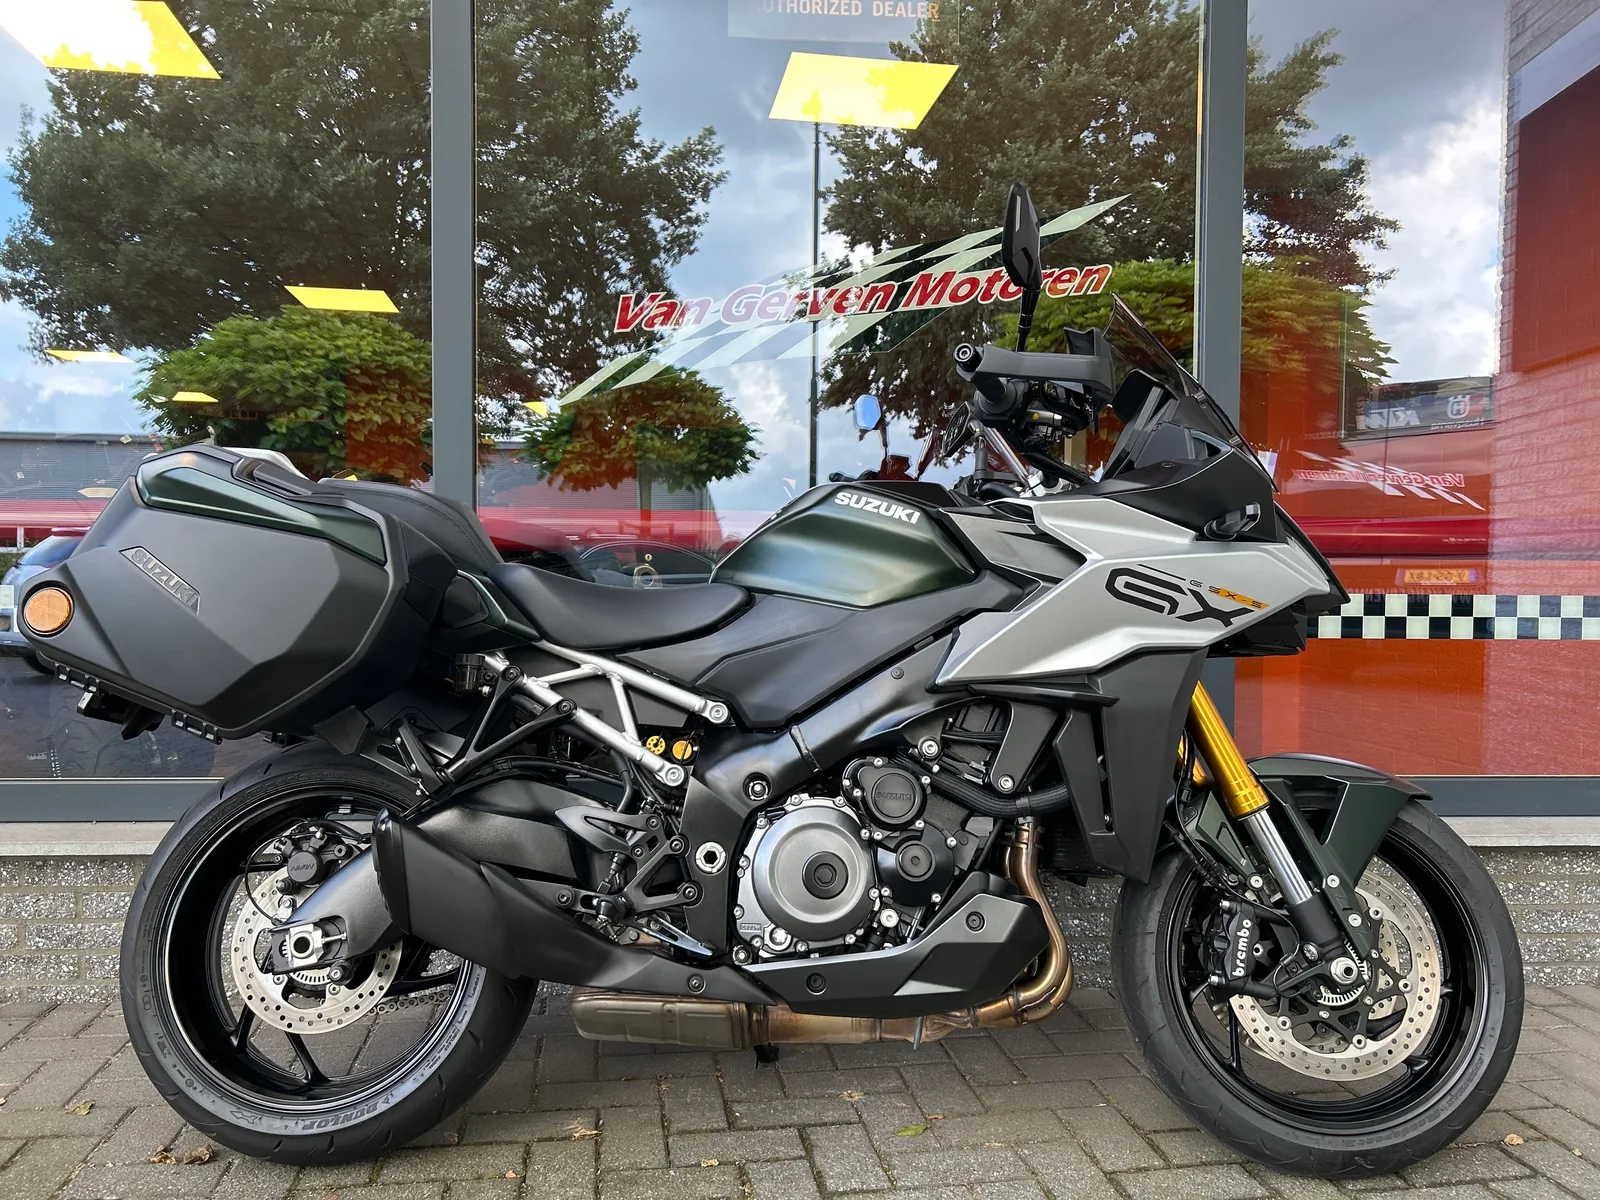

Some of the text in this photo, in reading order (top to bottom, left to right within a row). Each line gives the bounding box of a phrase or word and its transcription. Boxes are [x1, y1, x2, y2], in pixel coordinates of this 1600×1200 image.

[755, 0, 940, 19] UTHORIZED DEALER
[613, 291, 713, 333] Van
[721, 281, 897, 326] Gerven
[834, 491, 921, 525] SUZUKI
[131, 549, 198, 606] SUZUKI
[875, 791, 913, 801] SUZUKI
[1231, 919, 1252, 977] brembo
[302, 1100, 380, 1131] DUNLOP
